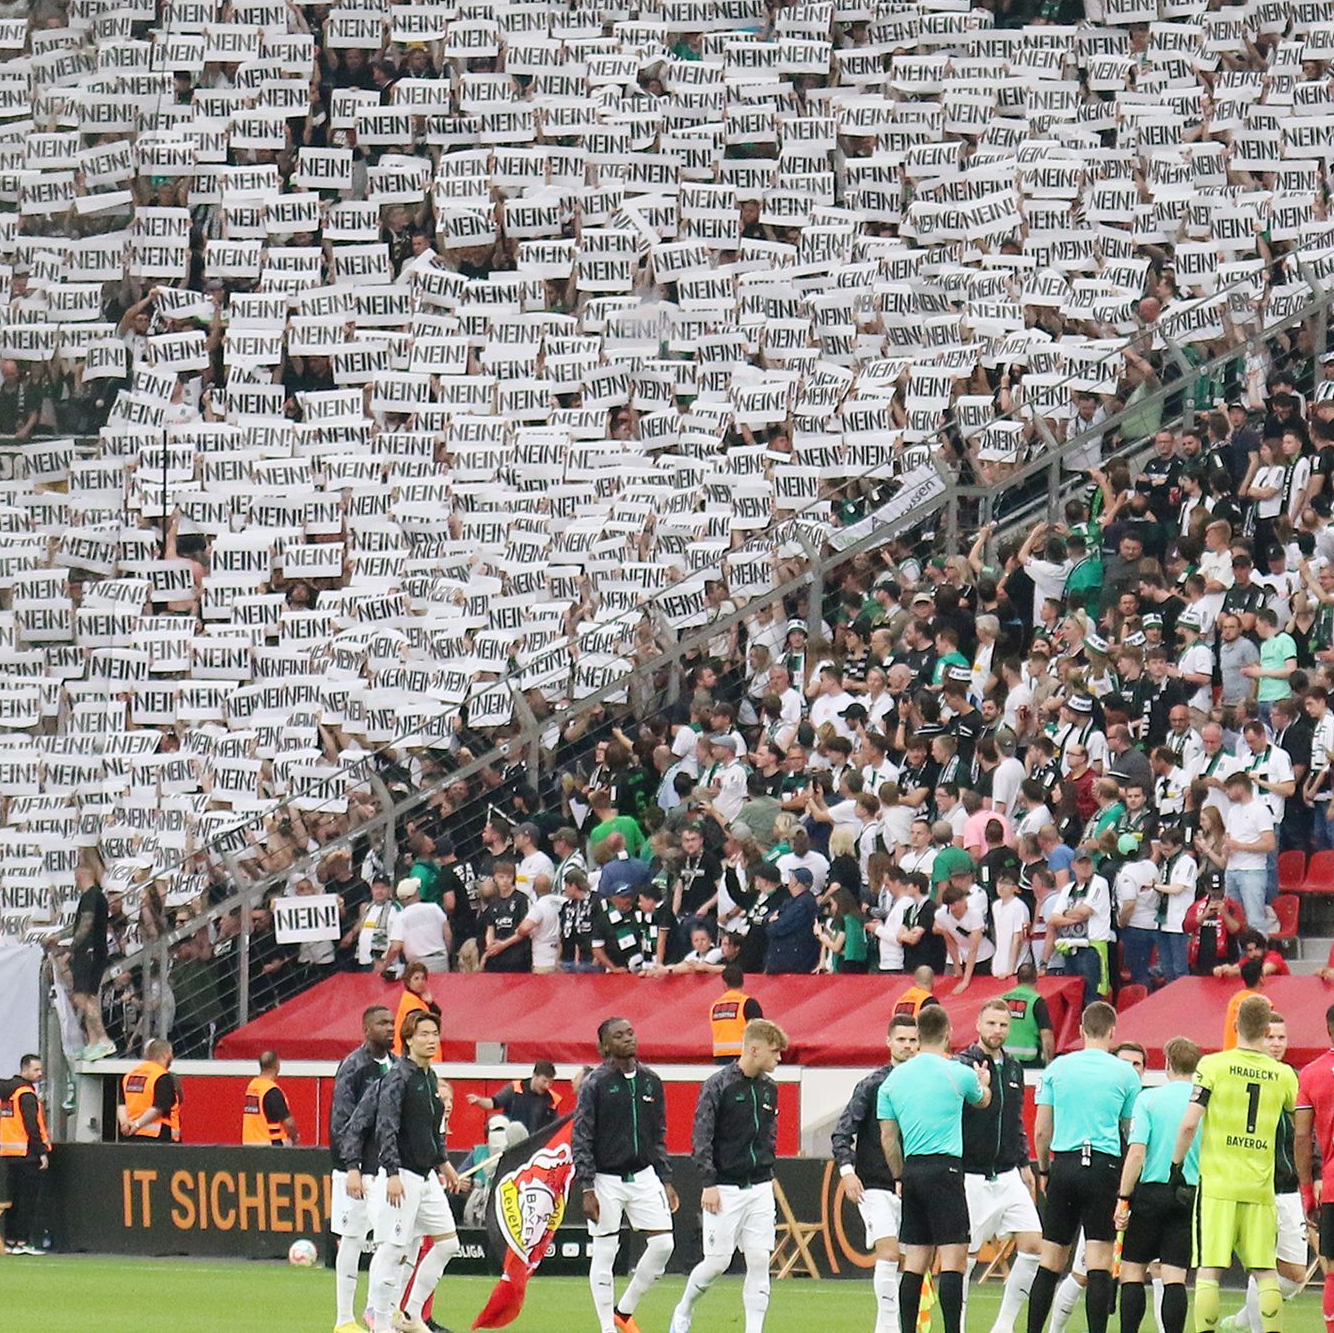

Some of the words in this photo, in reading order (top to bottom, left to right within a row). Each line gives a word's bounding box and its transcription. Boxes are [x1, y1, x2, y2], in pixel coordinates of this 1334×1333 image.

[783, 121, 833, 140] NEIN!
[300, 158, 349, 178] NEIN!
[1091, 191, 1134, 211] NEIN!
[330, 211, 376, 229] NEIN!
[507, 207, 558, 227] NEIN!
[207, 249, 257, 266] NEIN!
[468, 286, 517, 304] NEIN!
[680, 279, 731, 299] NEIN!
[153, 340, 205, 363] NEIN!
[776, 477, 816, 497] NEIN!
[193, 648, 248, 668] NEIN!
[277, 906, 336, 930] NEIN!
[1229, 1066, 1279, 1081] HRADECKY
[1246, 1083, 1261, 1134] 1
[122, 1170, 157, 1227] IT
